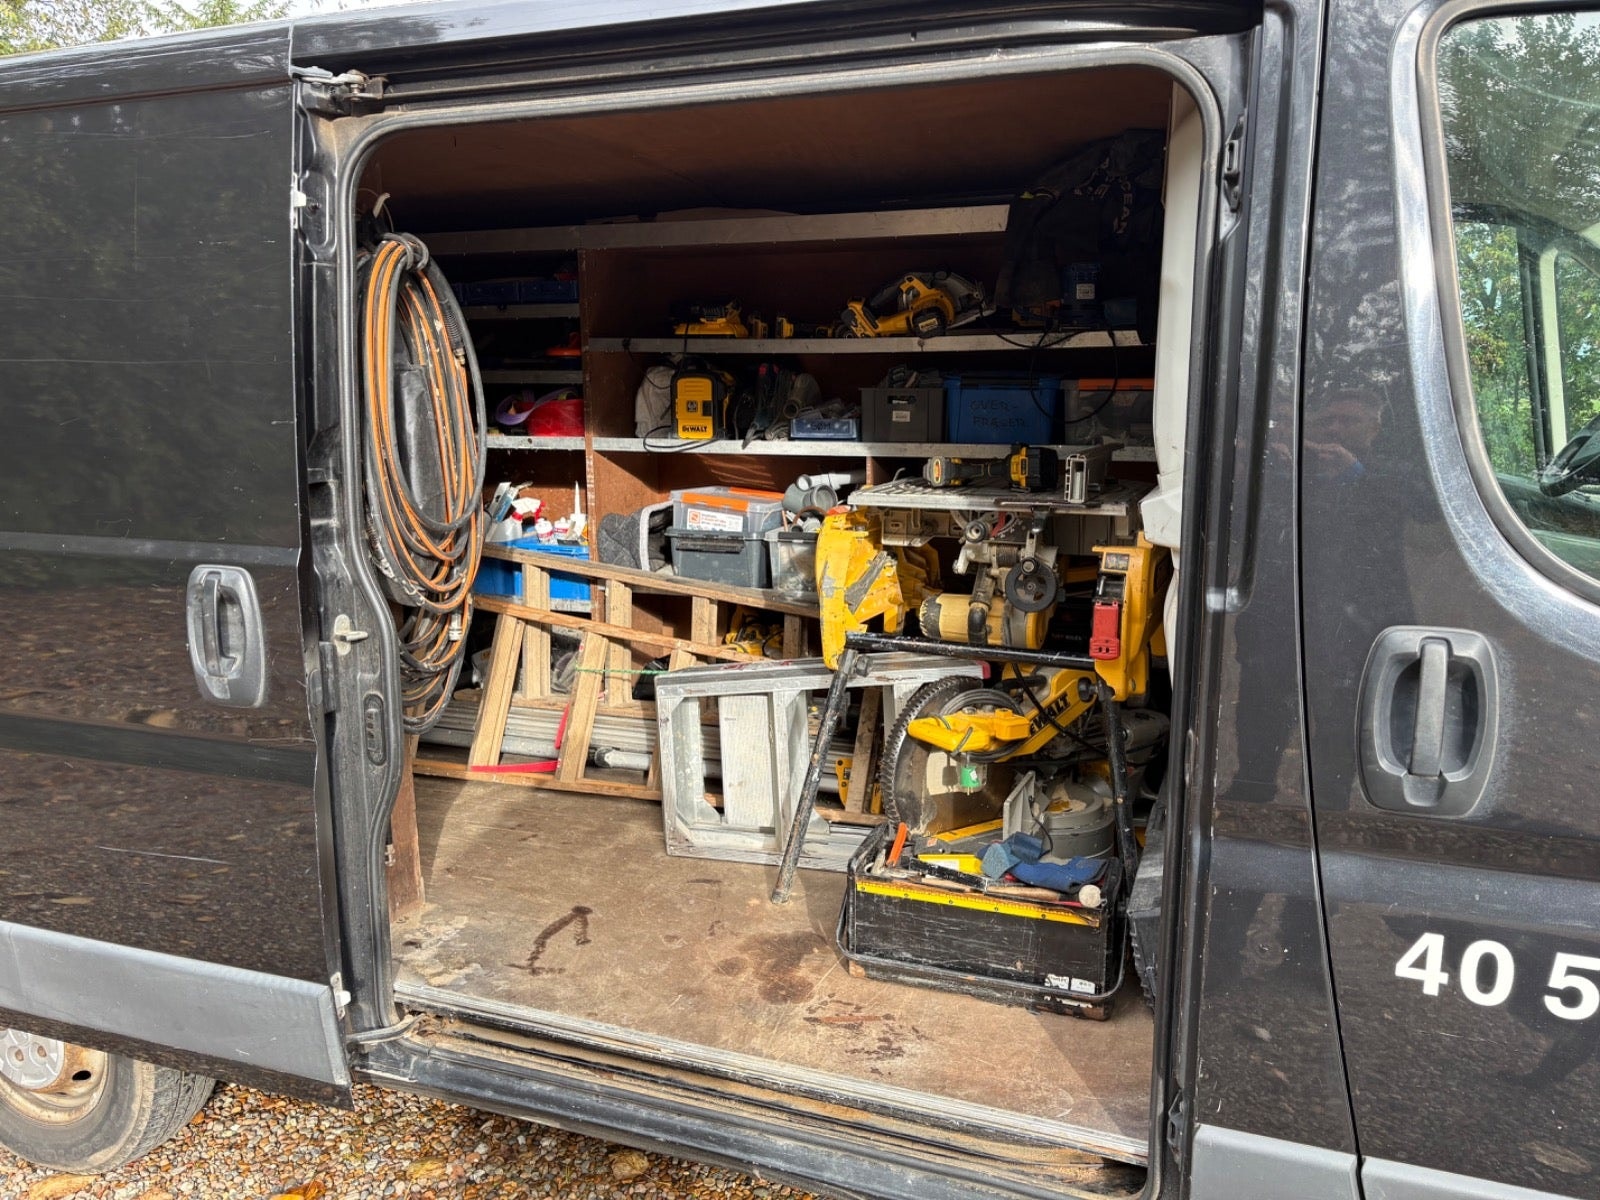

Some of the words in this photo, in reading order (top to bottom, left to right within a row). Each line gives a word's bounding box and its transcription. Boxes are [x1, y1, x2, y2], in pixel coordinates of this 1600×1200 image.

[1029, 690, 1071, 736] EWALT
[1395, 932, 1515, 1007] 40
[1544, 951, 1600, 1021] 5
